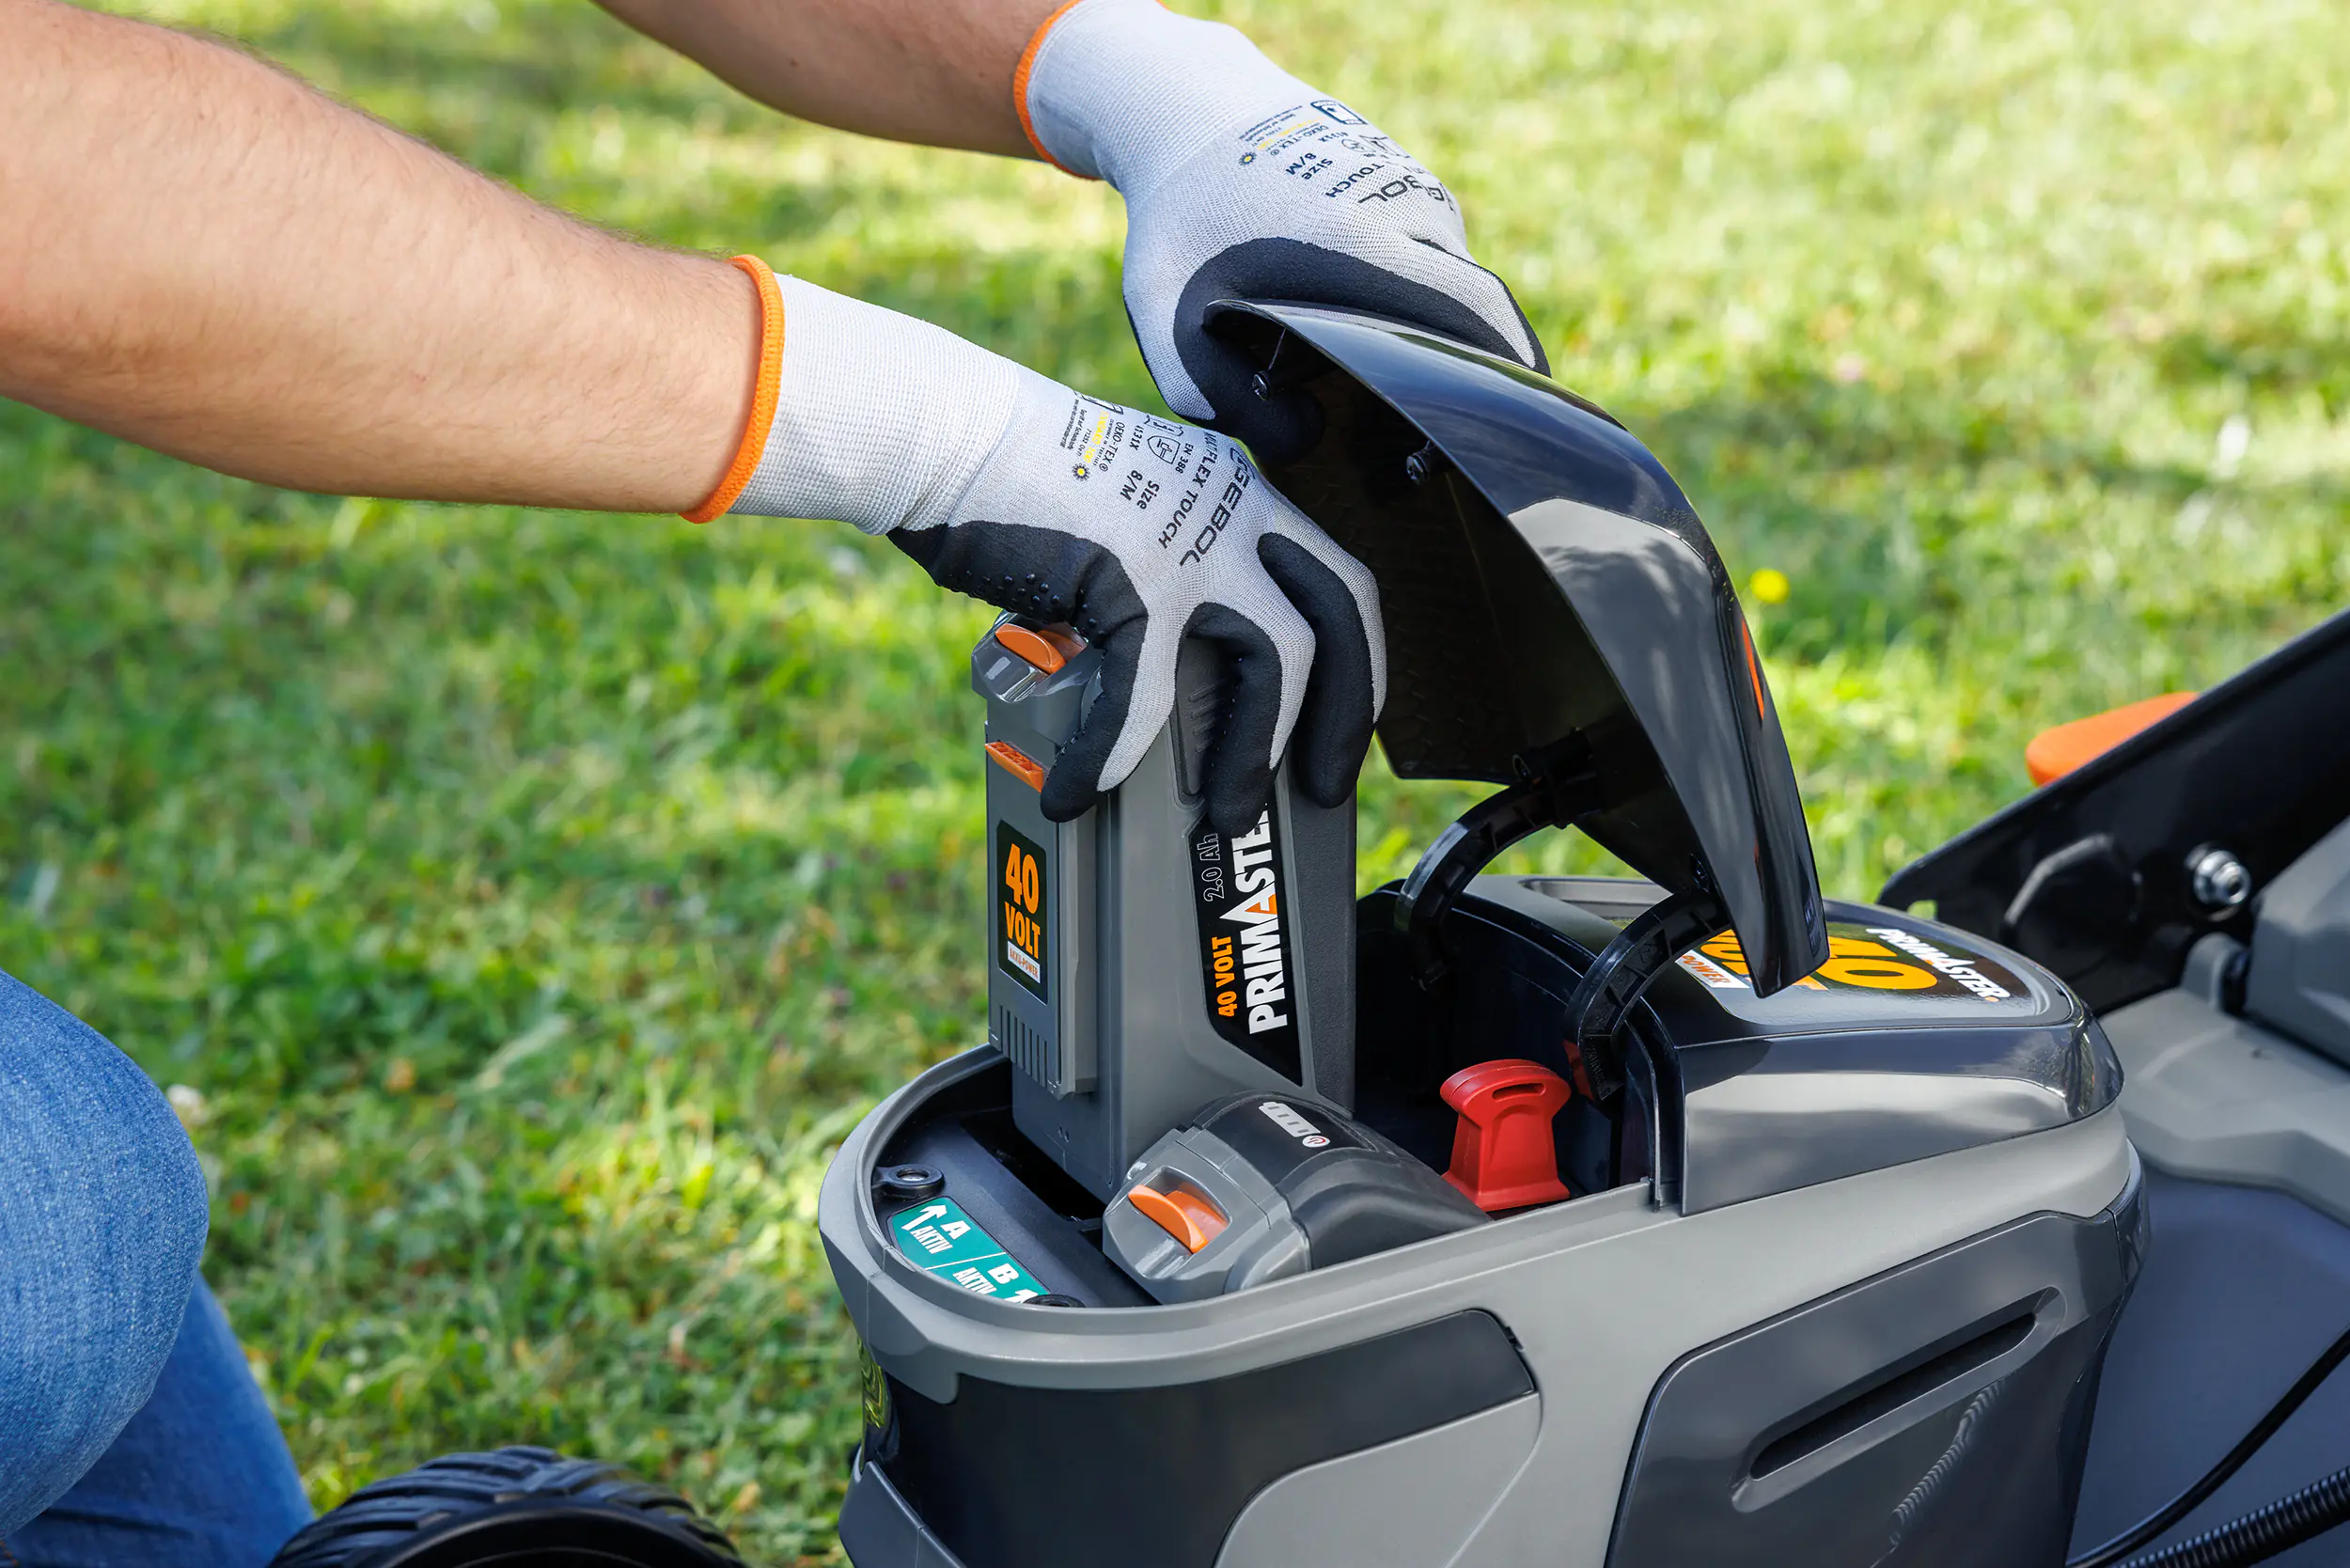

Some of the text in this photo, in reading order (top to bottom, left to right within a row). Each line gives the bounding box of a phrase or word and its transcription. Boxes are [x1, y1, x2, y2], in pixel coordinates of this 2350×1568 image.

[1285, 151, 1317, 176] 8/M
[1324, 162, 1385, 198] TOUCH
[1102, 421, 1126, 464] OEKO-TEX
[1175, 443, 1194, 474] EN 388
[1119, 469, 1144, 501] 8/M
[1136, 479, 1160, 510] Size
[1157, 488, 1199, 549] TOUCH
[1179, 469, 1250, 567] GEBOL
[1005, 842, 1040, 915] 40
[1197, 832, 1226, 902] 2.0 Ah
[1004, 901, 1042, 960] VOLT
[1220, 808, 1289, 1034] PRIMASTE
[1009, 947, 1040, 980] AKKU-POWER
[1211, 935, 1238, 1017] 40 VOLT
[909, 1225, 954, 1255] AKTIV
[940, 1220, 972, 1240] A
[952, 1266, 997, 1294] AKTIV
[987, 1262, 1020, 1284] B
